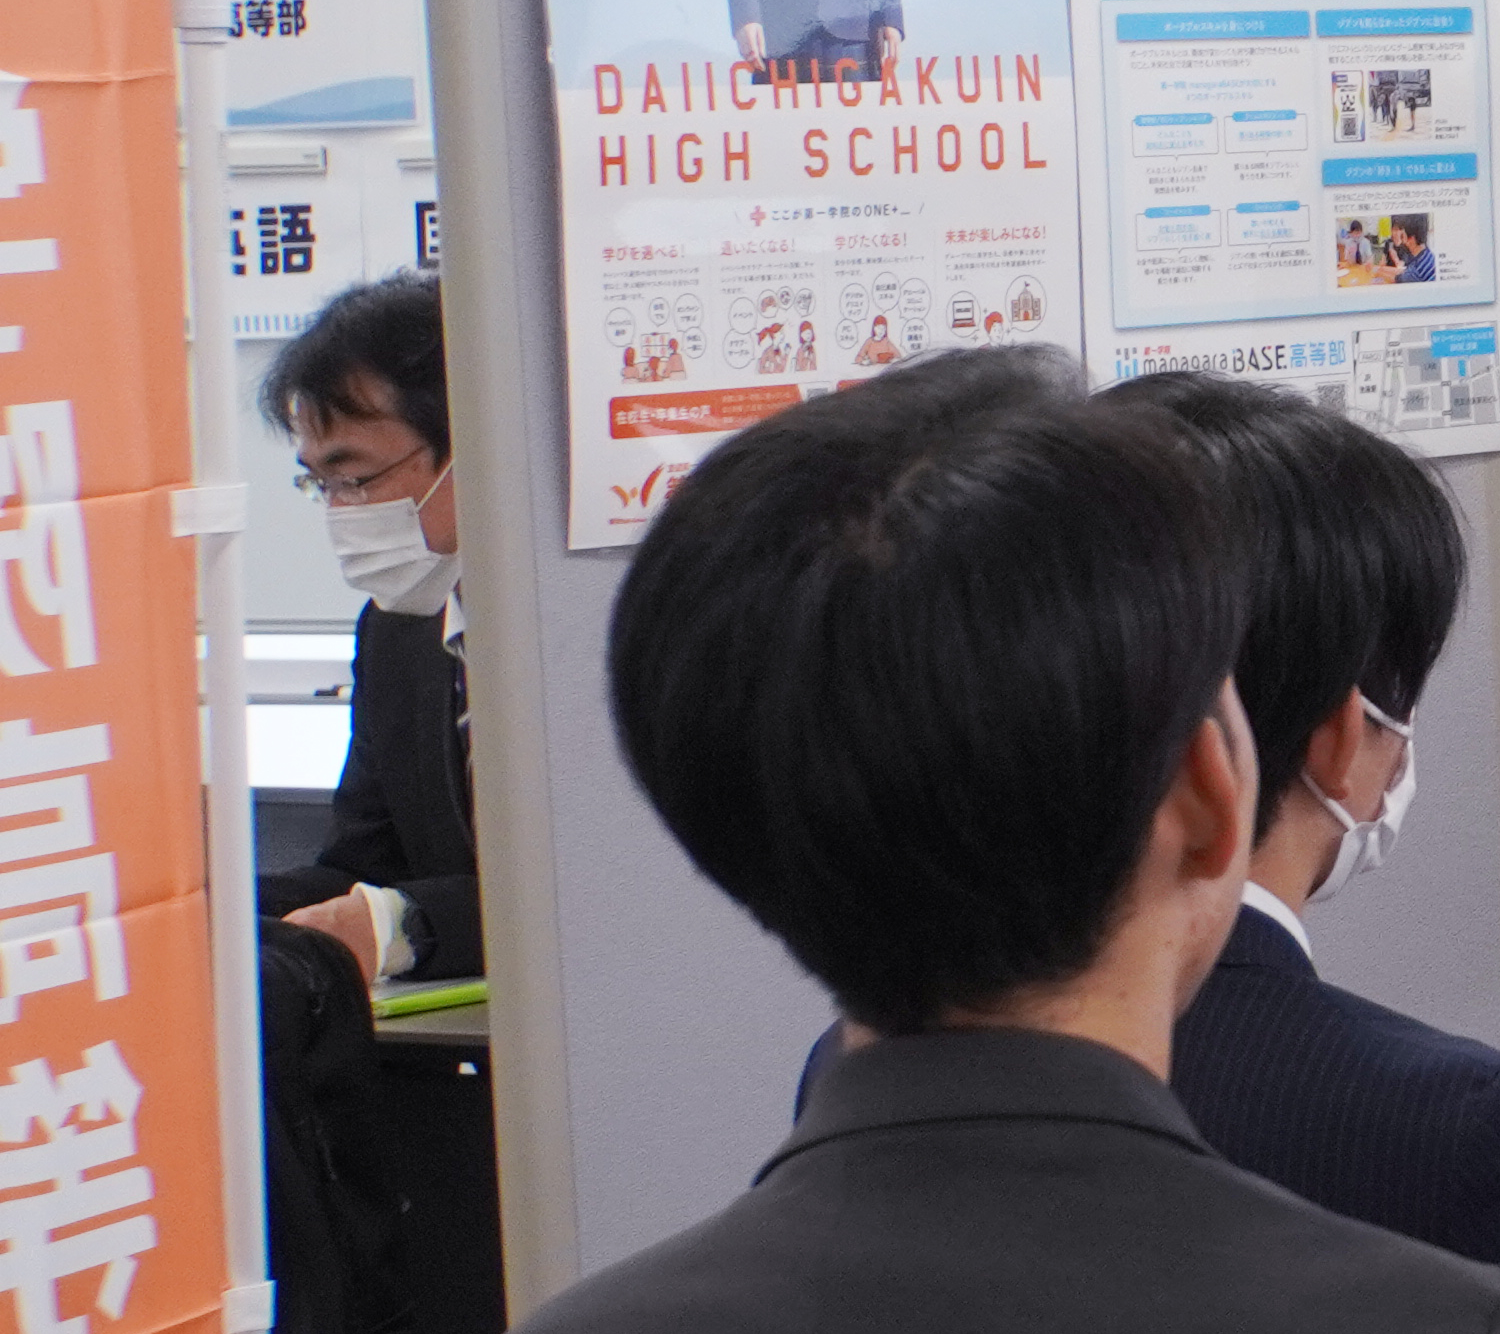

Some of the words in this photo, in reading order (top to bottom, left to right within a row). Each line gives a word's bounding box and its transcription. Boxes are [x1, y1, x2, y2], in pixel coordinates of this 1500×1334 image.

[593, 53, 1043, 115] DAIICHIGAKUIN
[599, 131, 751, 186] HIGH
[803, 121, 1048, 179] SCHOOL
[945, 226, 1047, 244] 未来が楽しみになる!
[1290, 340, 1347, 367] 高等部
